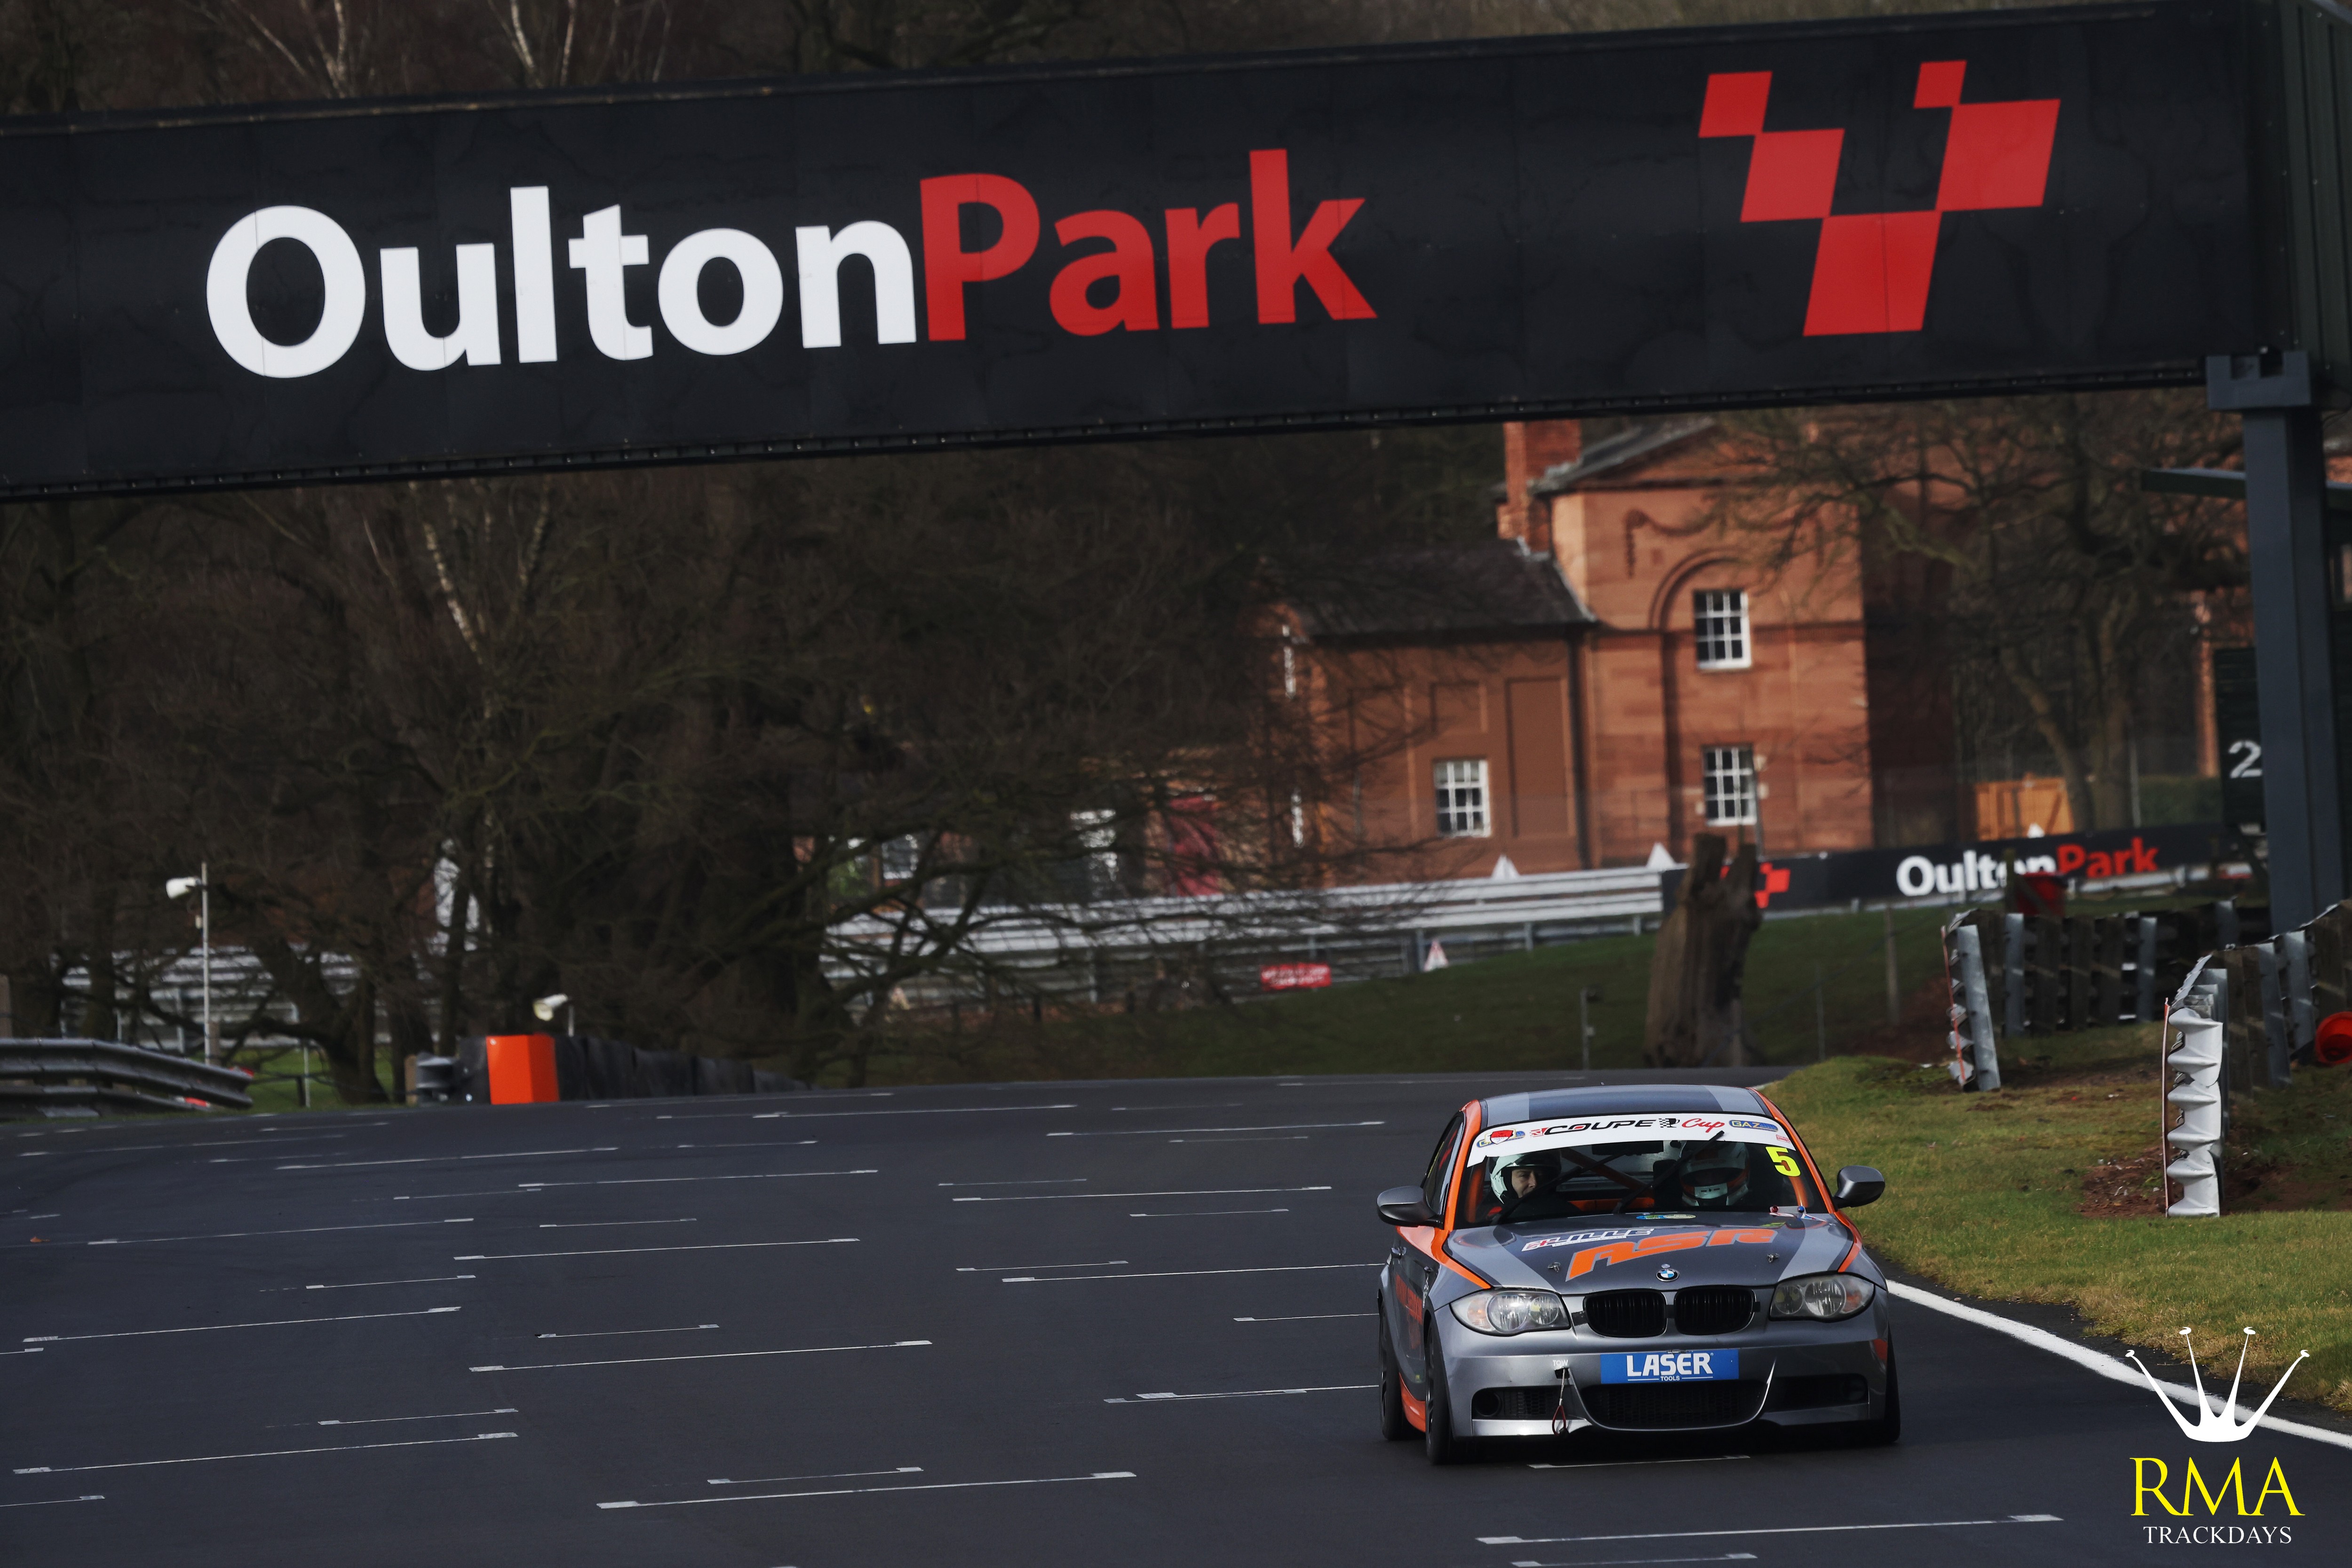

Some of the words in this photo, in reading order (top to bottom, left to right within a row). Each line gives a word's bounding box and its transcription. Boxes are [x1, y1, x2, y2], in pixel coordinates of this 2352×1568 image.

[2228, 740, 2263, 779] 2
[1543, 1120, 1657, 1135] COUPE
[1682, 1118, 1725, 1133] Cup
[1765, 1146, 1801, 1177] 5
[1626, 1353, 1714, 1377] LASER
